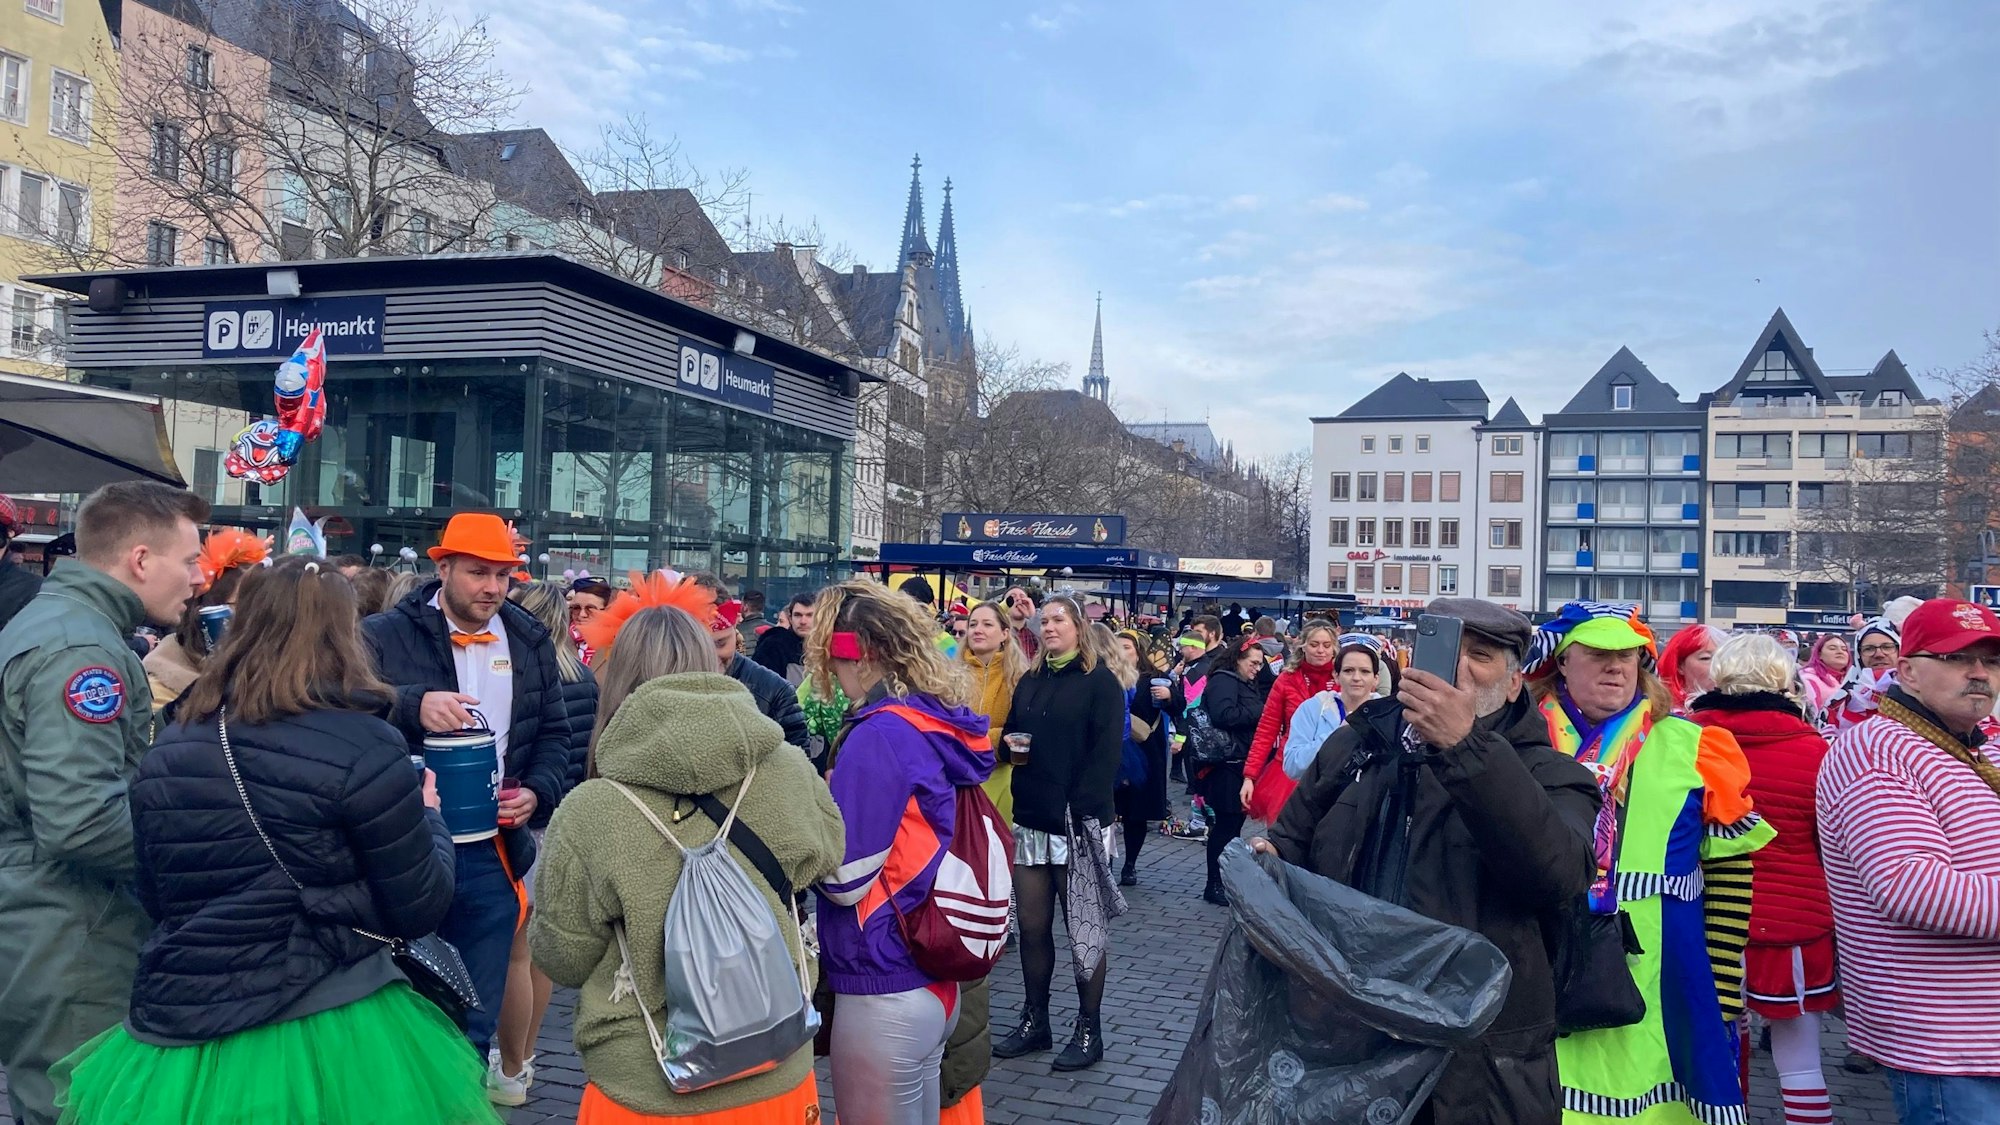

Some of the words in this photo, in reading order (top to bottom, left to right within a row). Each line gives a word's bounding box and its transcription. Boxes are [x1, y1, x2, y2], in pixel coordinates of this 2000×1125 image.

[285, 315, 376, 338] Heumarkt
[725, 369, 770, 398] Heumarkt
[1347, 552, 1369, 561] GAG
[1431, 554, 1442, 562] AG
[1822, 614, 1846, 624] Gaffel
